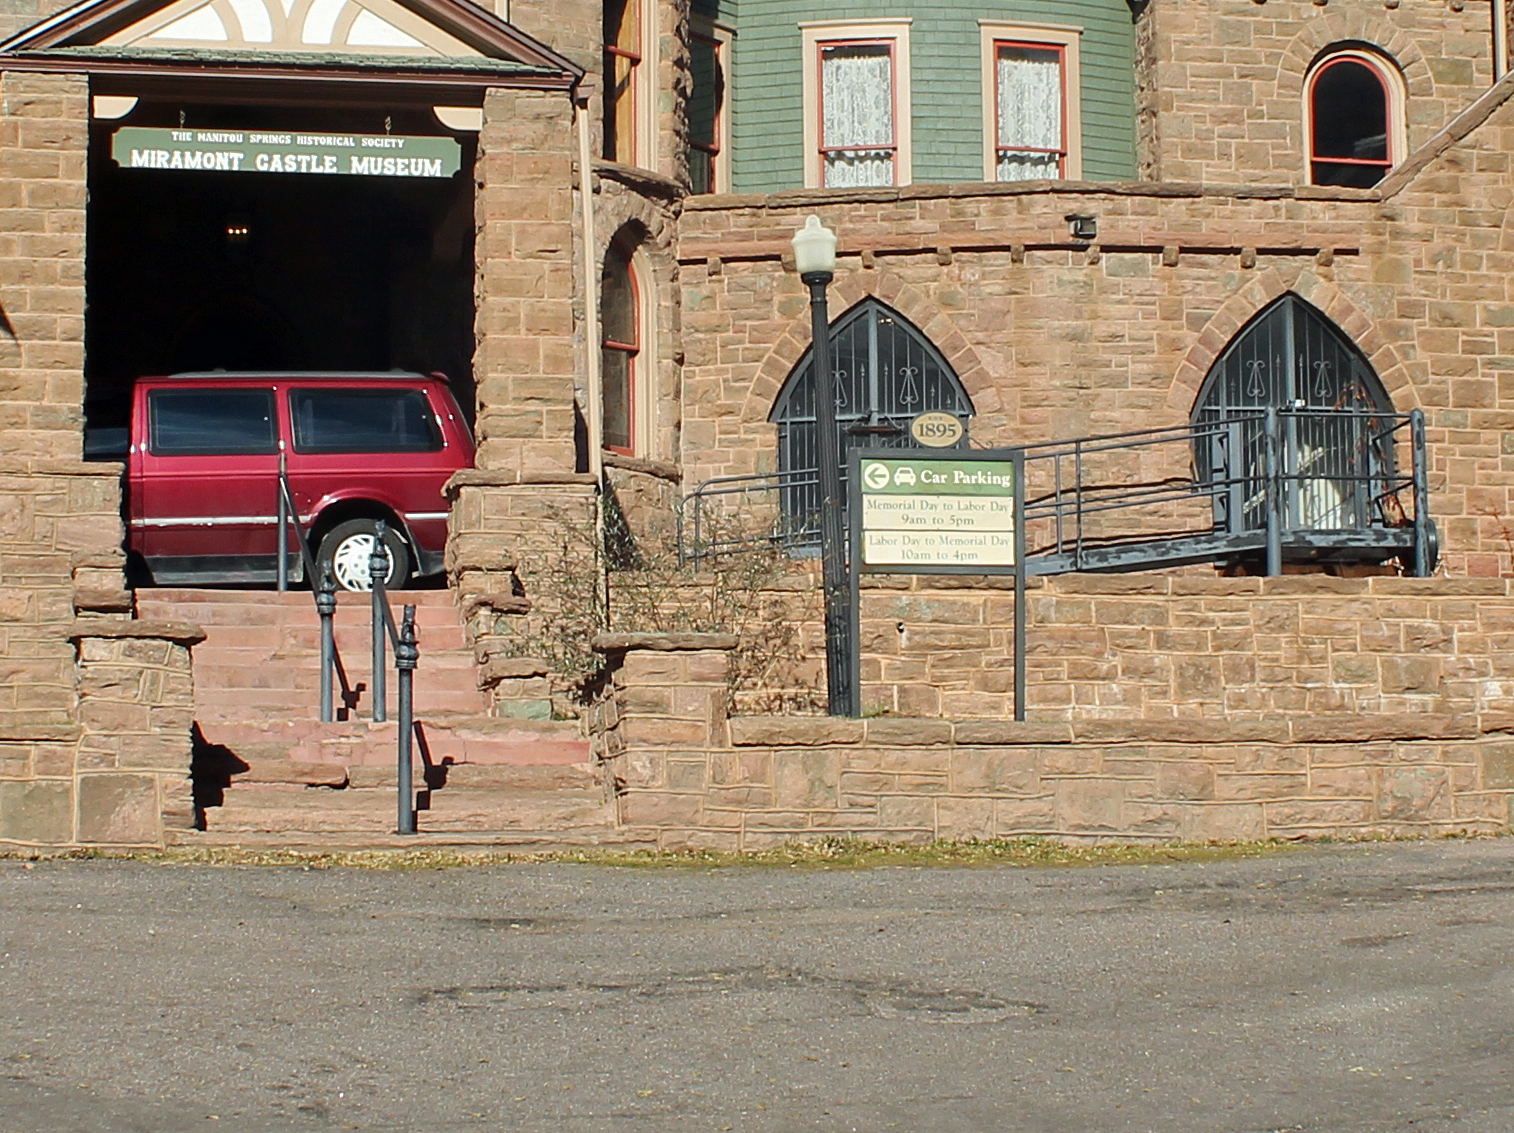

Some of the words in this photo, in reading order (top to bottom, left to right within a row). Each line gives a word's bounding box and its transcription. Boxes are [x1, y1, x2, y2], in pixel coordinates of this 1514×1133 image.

[170, 131, 192, 142] THE
[197, 132, 243, 143] MANITOU
[249, 134, 291, 145] SPRINGS
[297, 136, 355, 147] HISTORICAL
[361, 138, 404, 148] SOCIETY
[132, 149, 244, 171] MIRAMONT
[255, 153, 338, 174] CASTLE
[350, 156, 442, 178] MUSEUM
[918, 423, 957, 438] 1895
[920, 470, 948, 484] Car
[952, 470, 1011, 488] Parking
[866, 498, 916, 511] Memorial
[920, 500, 939, 513] Day
[943, 502, 954, 510] to
[957, 500, 986, 512] Labor
[990, 501, 1009, 514] Day
[901, 514, 926, 524] 9am
[932, 516, 944, 525] to
[949, 515, 974, 527] 5pm
[869, 535, 898, 546] Labor
[902, 536, 921, 548] Day
[925, 537, 935, 546] to
[939, 535, 986, 546] Memorial
[991, 536, 1010, 548] Day
[901, 550, 931, 560] 10am
[937, 551, 948, 560] to
[953, 550, 978, 562] 4pm
